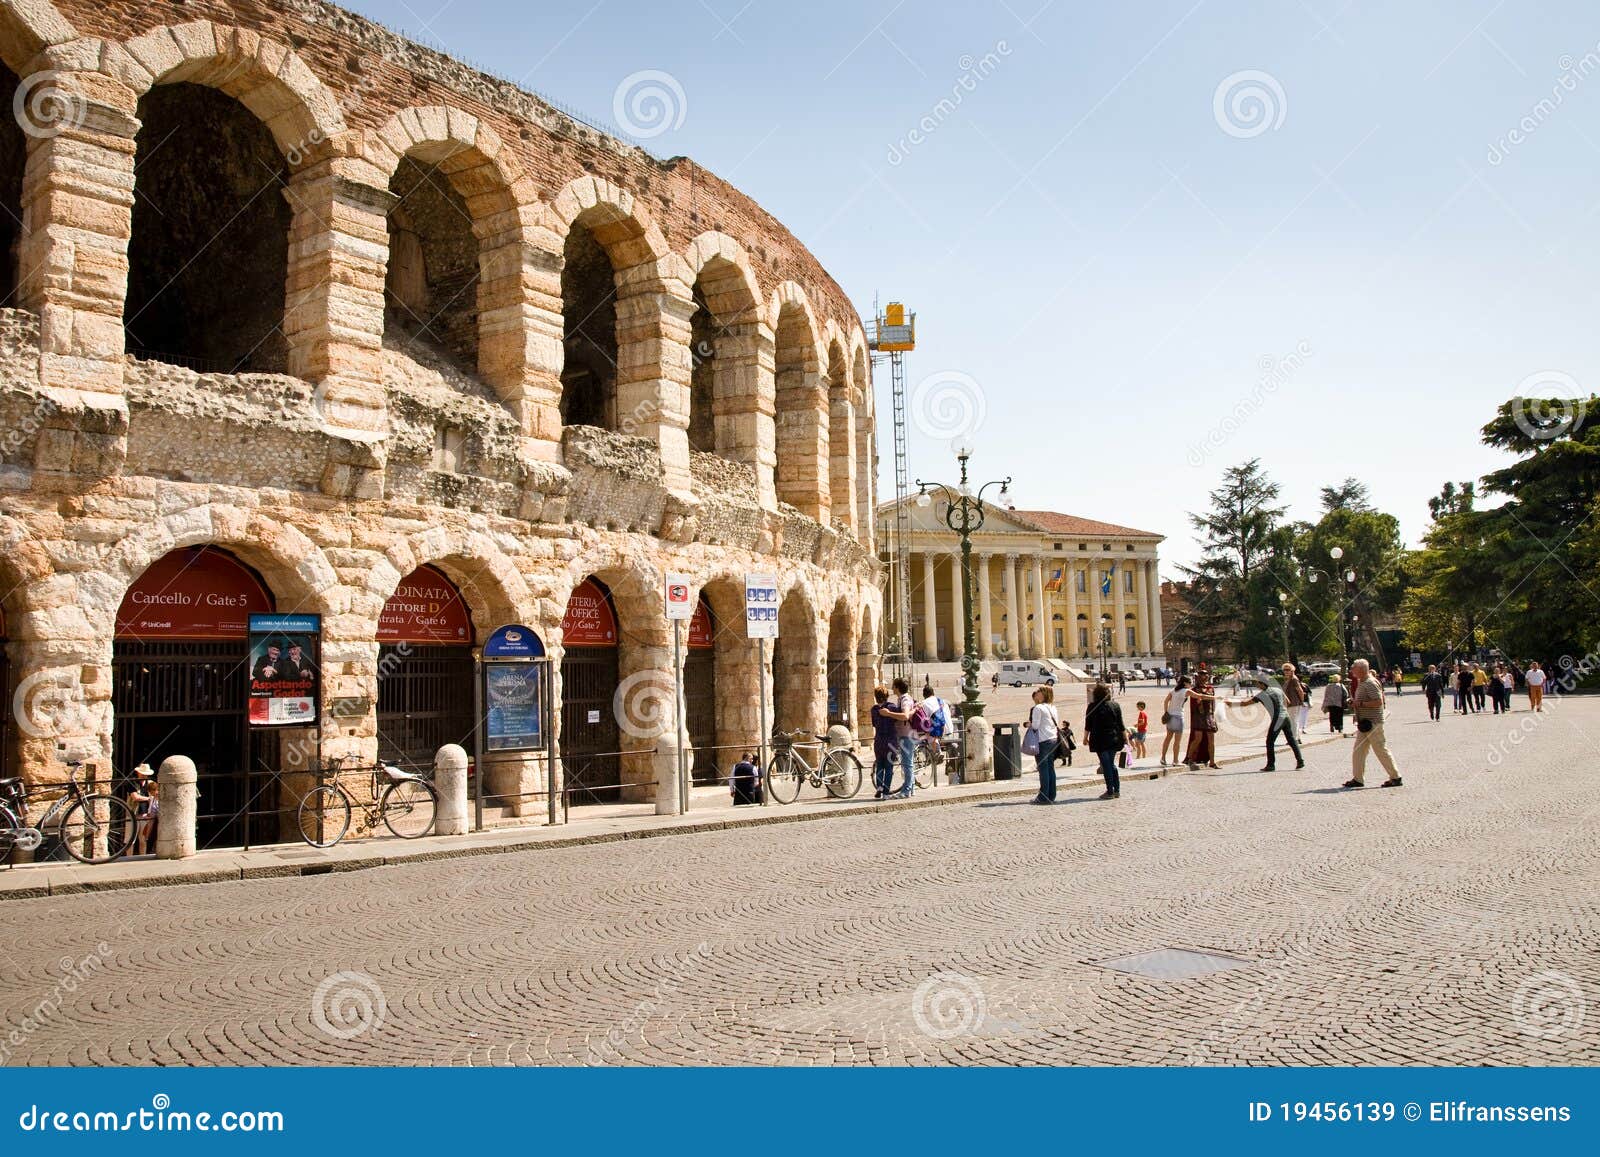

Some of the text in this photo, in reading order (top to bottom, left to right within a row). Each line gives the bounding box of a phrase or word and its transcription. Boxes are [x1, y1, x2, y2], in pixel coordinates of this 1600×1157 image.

[394, 586, 451, 600] DINATA
[132, 591, 247, 607] Cancello / Gate 5
[567, 596, 597, 608] TTERIA
[384, 602, 440, 614] ETTORE D
[571, 608, 600, 619] OFFICE
[407, 615, 413, 625] /
[415, 615, 439, 625] Gate
[439, 615, 447, 625] 6
[561, 620, 570, 628] llo
[577, 621, 595, 630] Gate
[595, 621, 601, 630] 7
[251, 680, 312, 691] Aspettando
